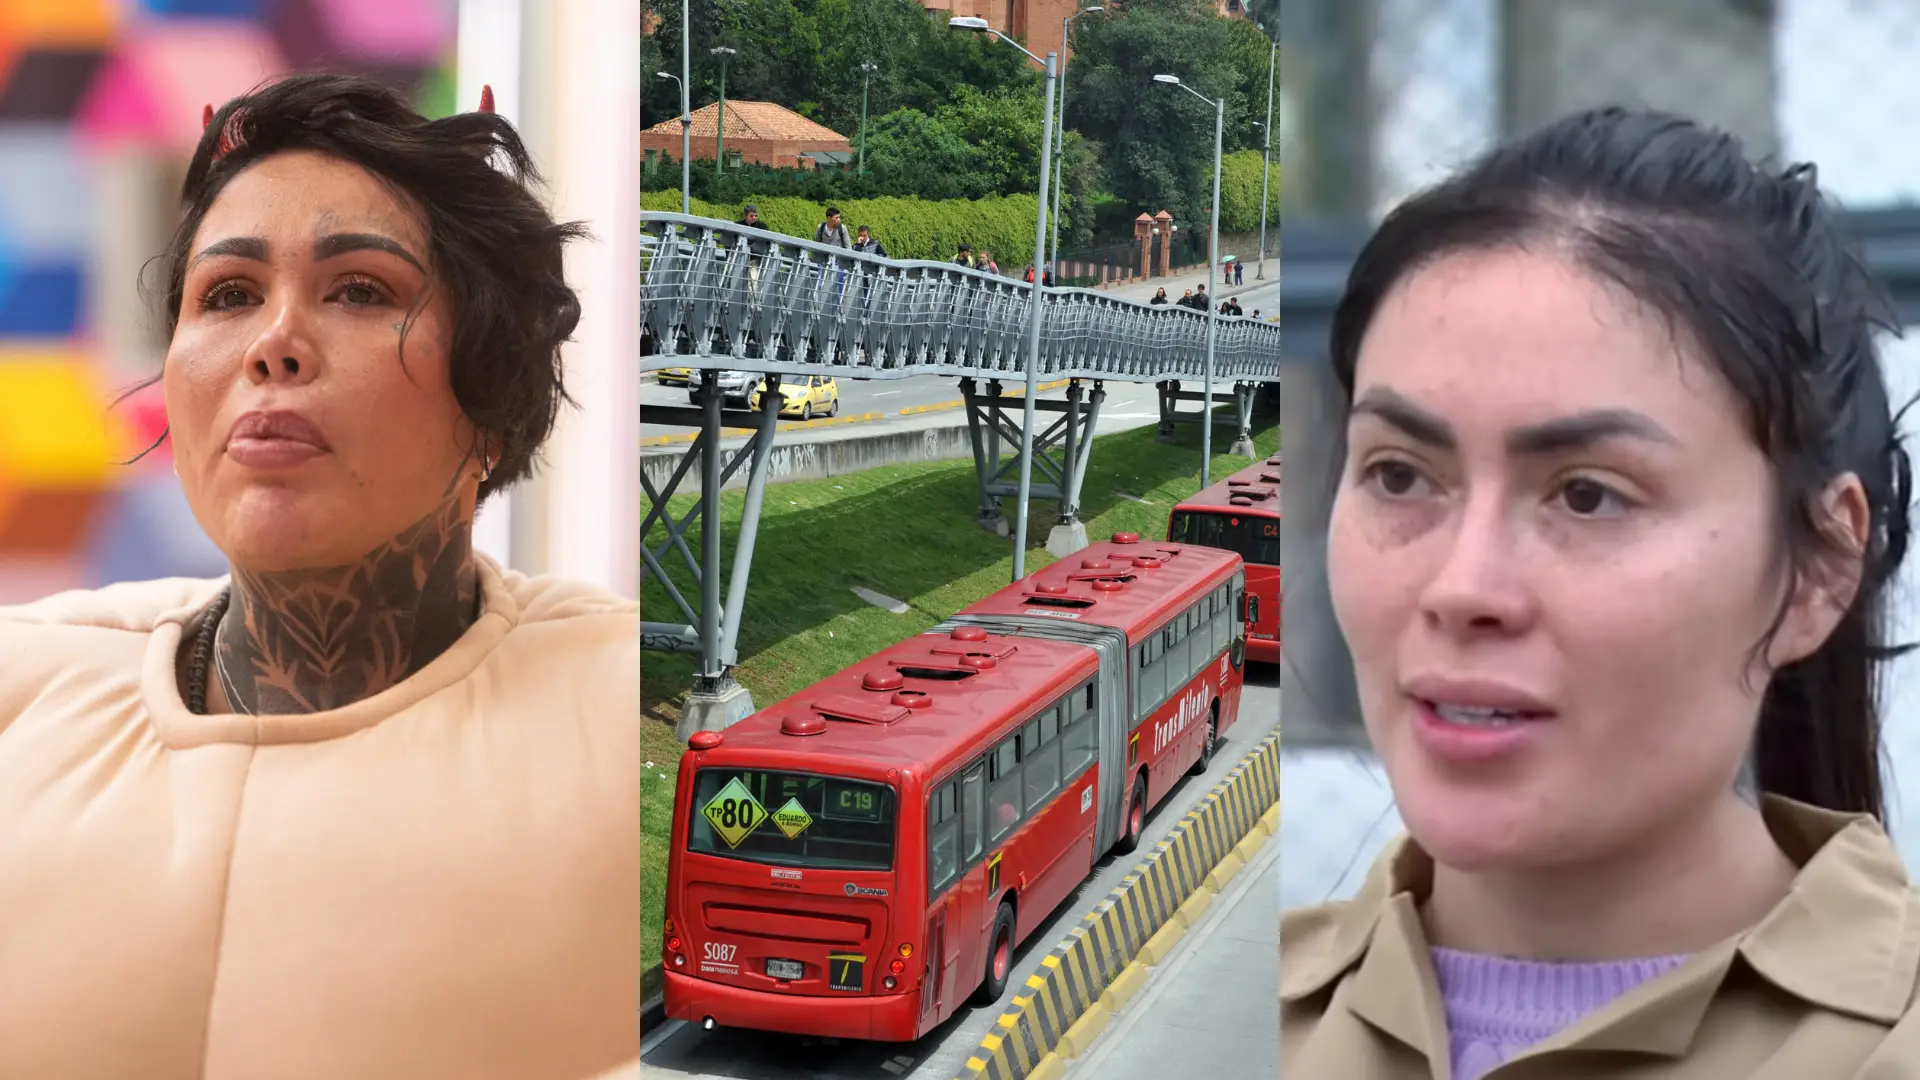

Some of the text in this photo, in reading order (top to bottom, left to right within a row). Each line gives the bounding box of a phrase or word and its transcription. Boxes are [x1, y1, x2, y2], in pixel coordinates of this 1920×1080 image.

[1153, 678, 1209, 756] TransMilenio
[778, 813, 807, 823] EDUARDO
[857, 887, 888, 896] SCANIA
[704, 941, 738, 962] S087
[830, 984, 862, 992] TRANSMILENIO
